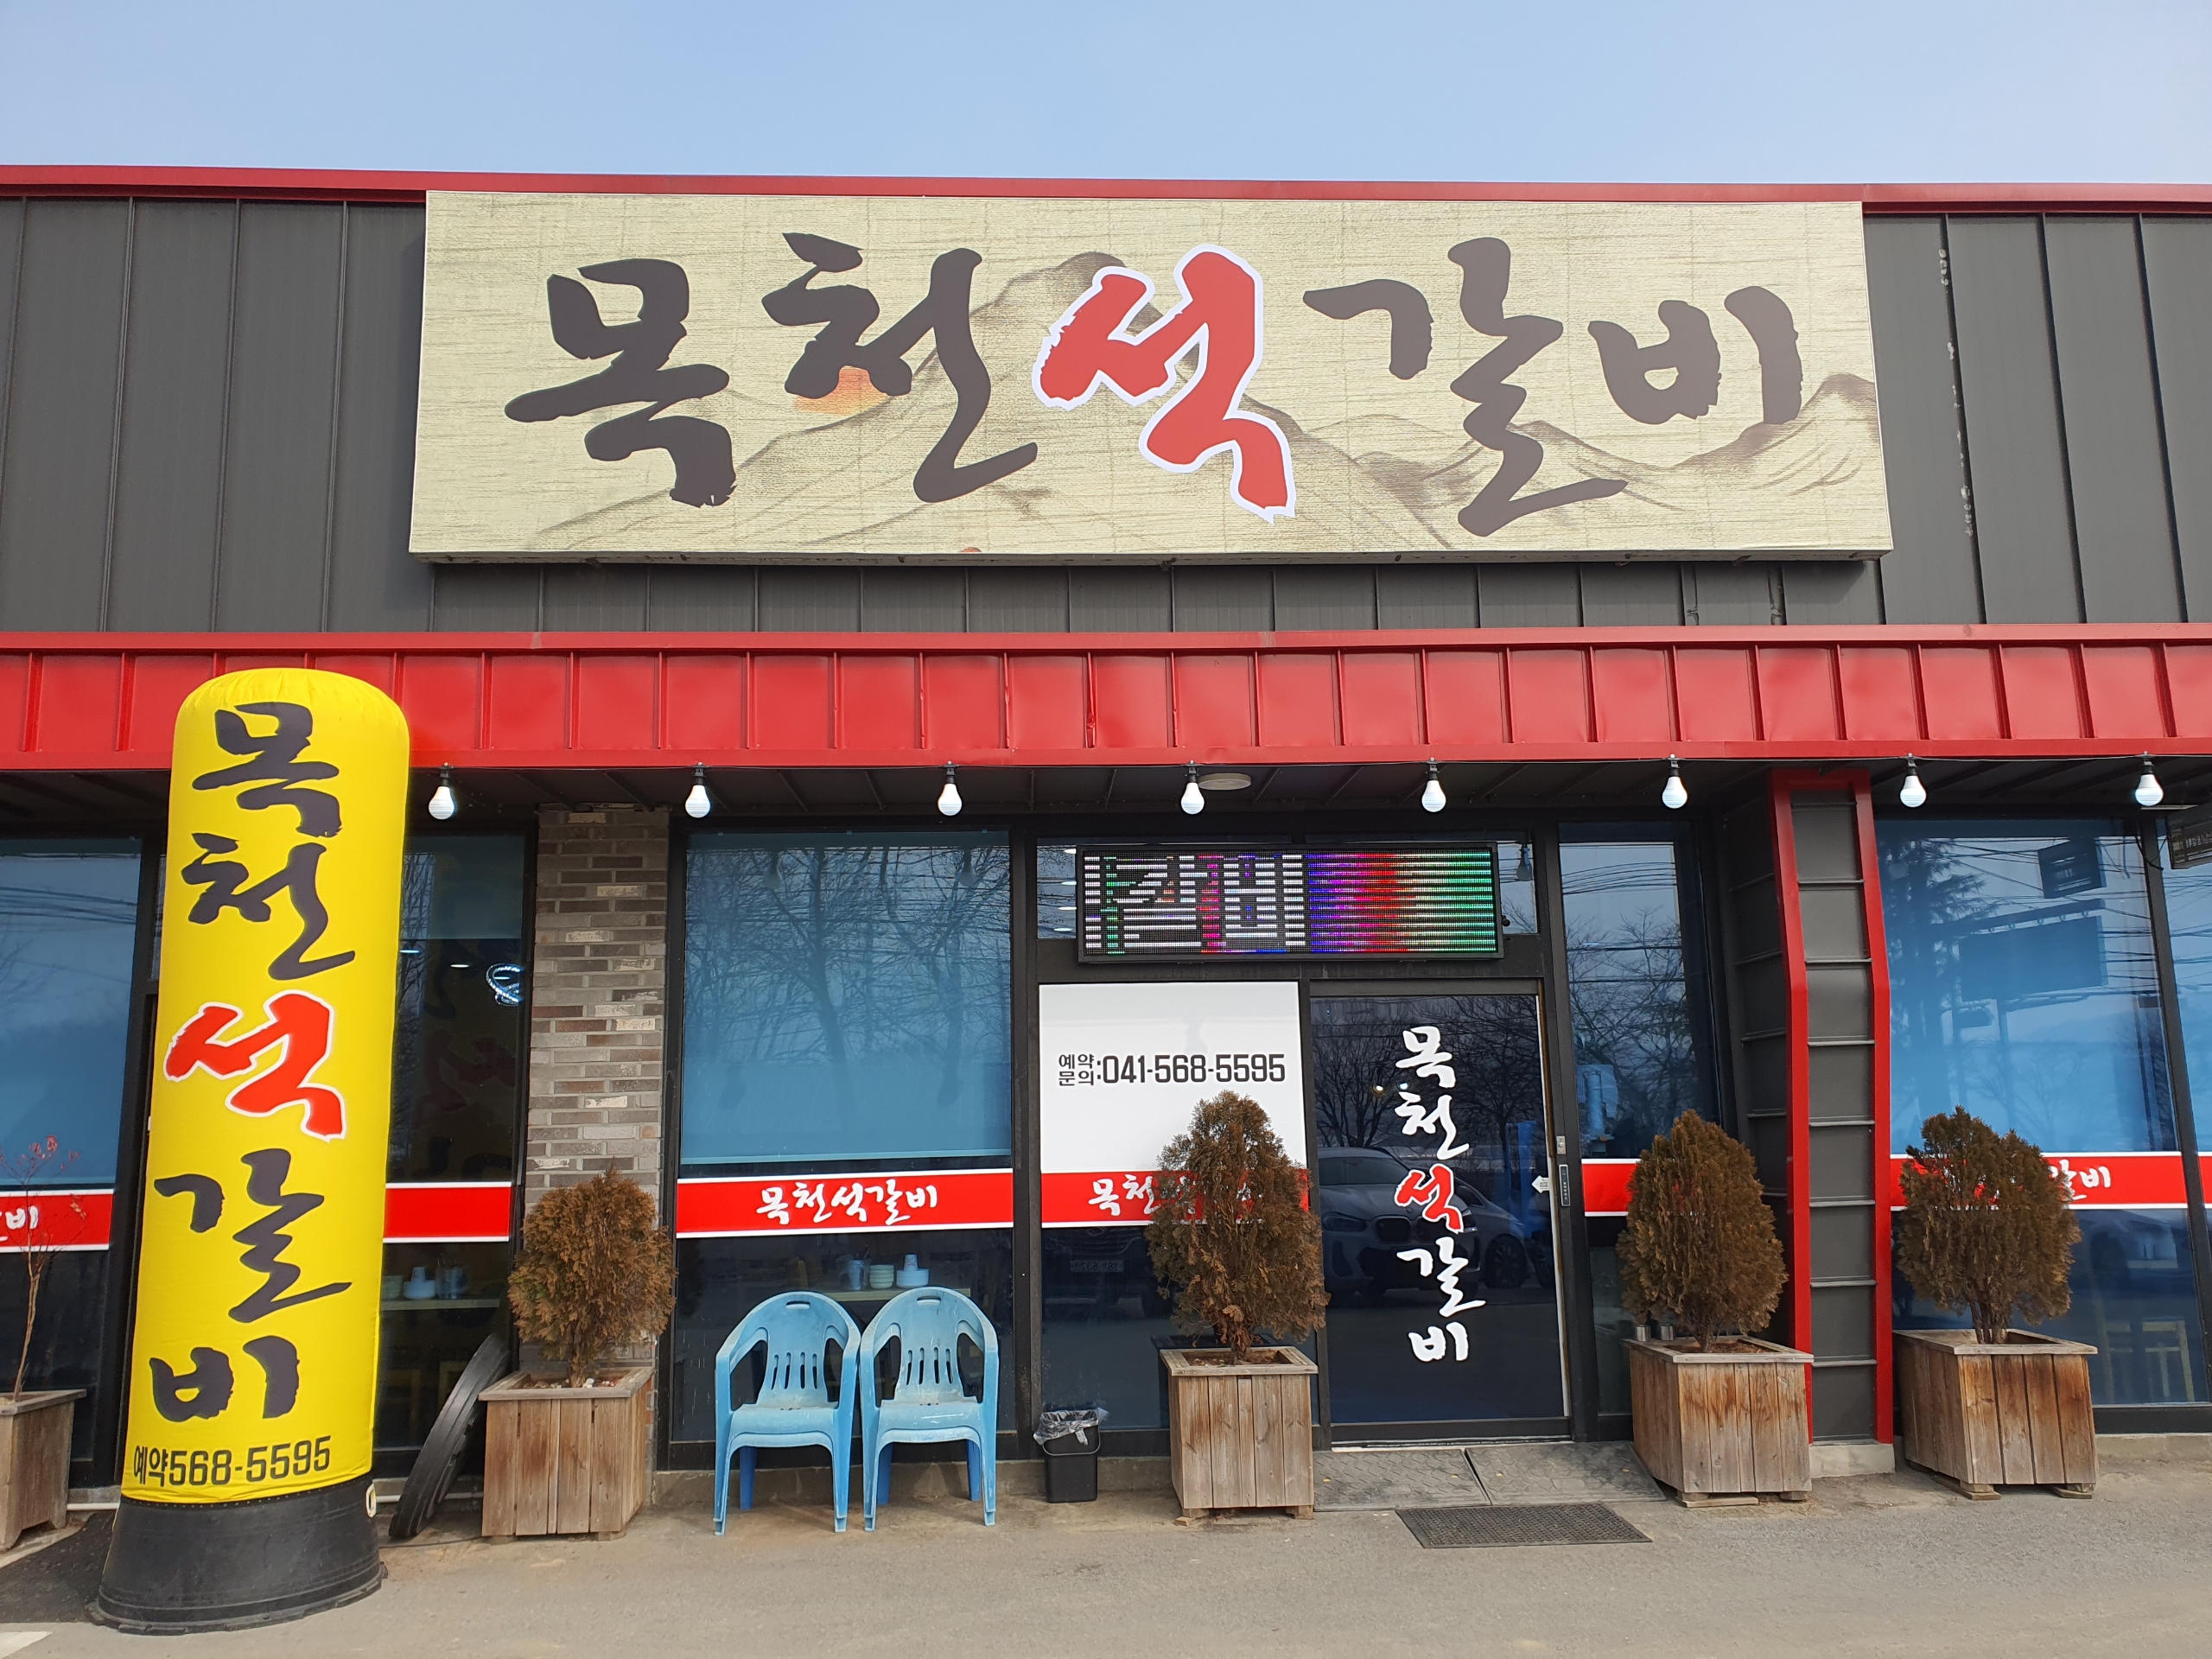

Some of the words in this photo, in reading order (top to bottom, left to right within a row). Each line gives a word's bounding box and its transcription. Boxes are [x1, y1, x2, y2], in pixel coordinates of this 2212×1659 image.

[505, 232, 1803, 537] 목천석갈비
[151, 702, 355, 1423] 목천석갈비
[1058, 1053, 1095, 1070] 예약
[1058, 1071, 1095, 1086] 문의
[756, 1178, 938, 1225] 목천석갈비
[1394, 1026, 1486, 1362] 목천석갈비
